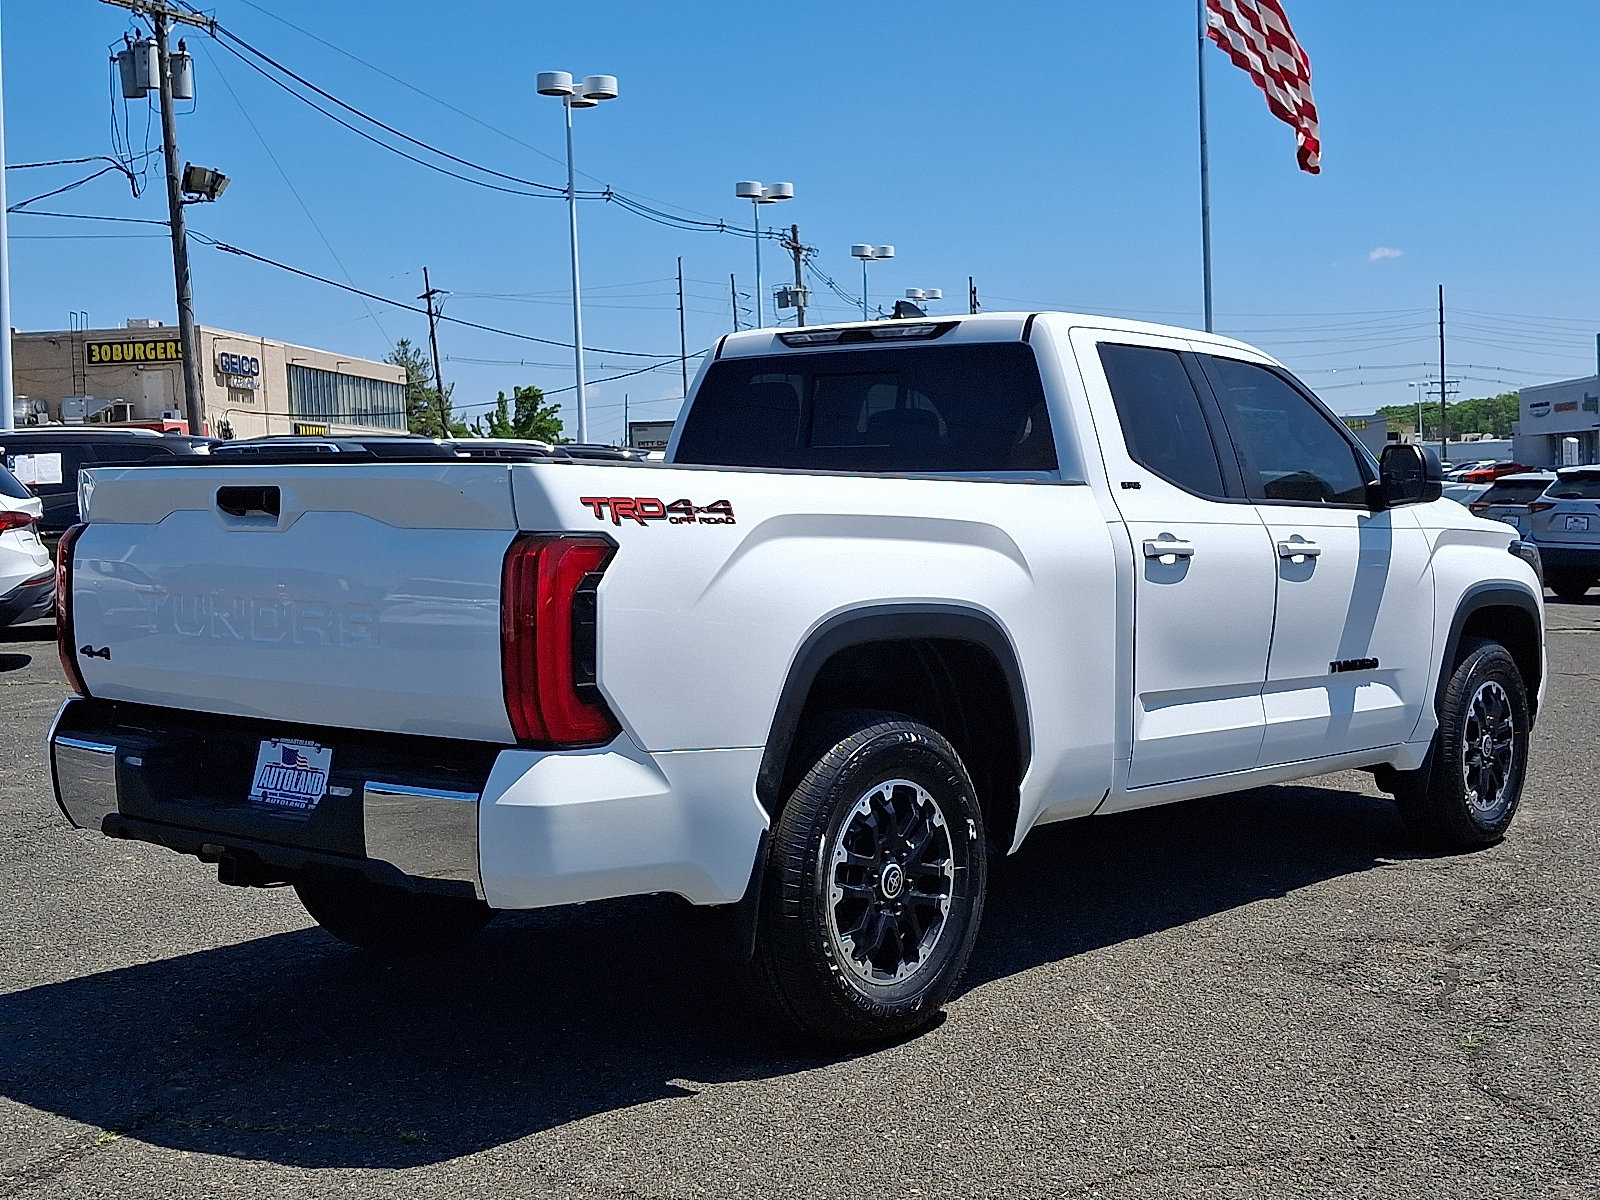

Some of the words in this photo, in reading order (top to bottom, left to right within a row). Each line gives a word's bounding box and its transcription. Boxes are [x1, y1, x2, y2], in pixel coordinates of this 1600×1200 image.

[220, 352, 260, 377] GEICO
[580, 497, 667, 527] TRD
[669, 516, 696, 525] OFF
[698, 516, 736, 525] ROAD
[259, 766, 324, 795] AUTOLAND
[264, 797, 306, 809] AUTOLAND
